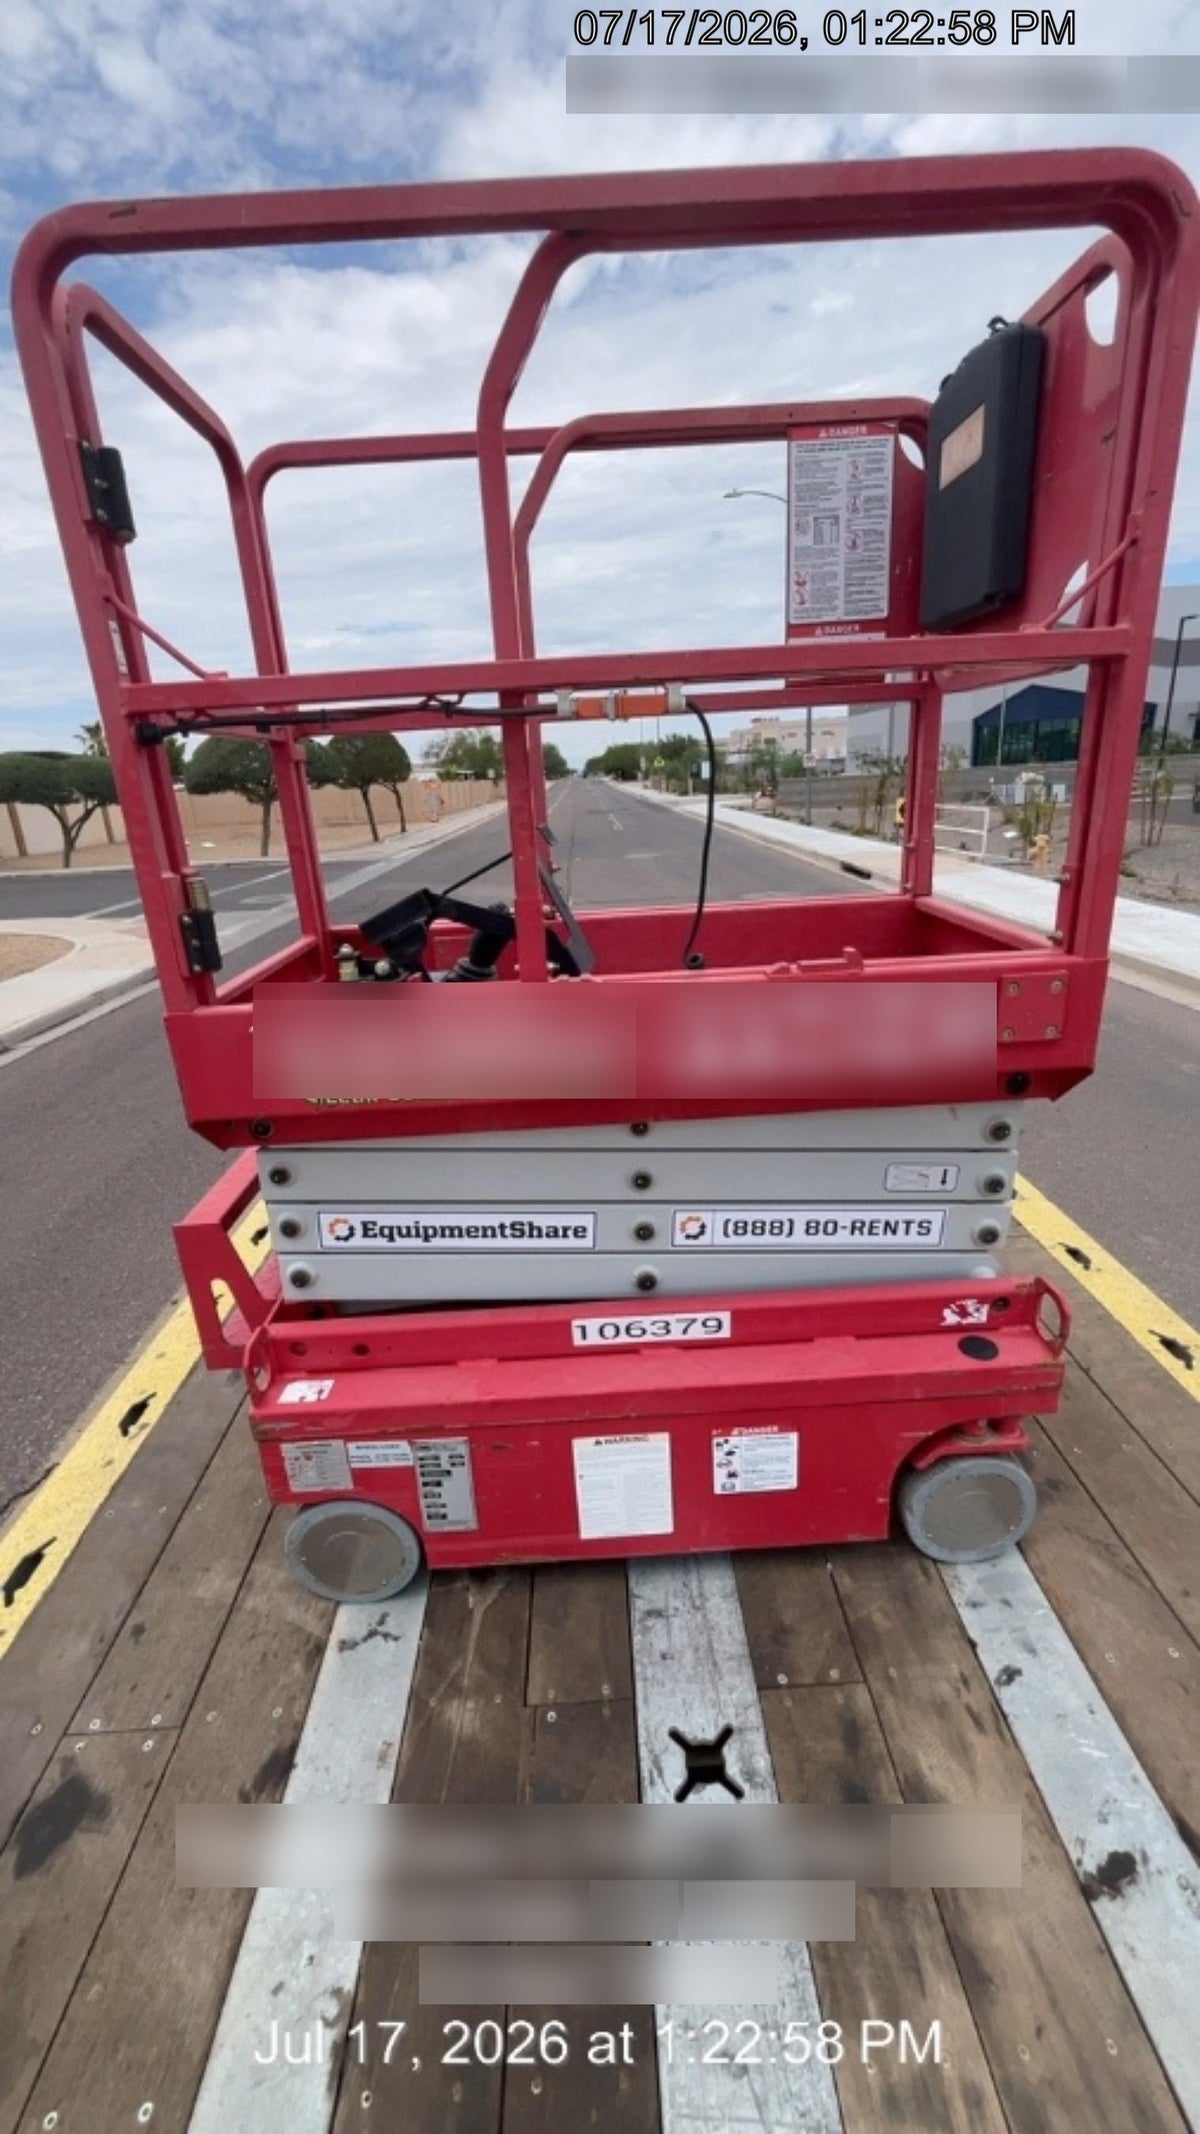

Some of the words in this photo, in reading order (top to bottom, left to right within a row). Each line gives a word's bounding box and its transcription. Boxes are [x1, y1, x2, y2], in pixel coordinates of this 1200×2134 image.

[361, 1220, 588, 1243] EquipmentShare
[723, 1218, 795, 1238] (888)
[805, 1219, 933, 1236] 80-RENTS
[574, 1316, 723, 1340] 106379
